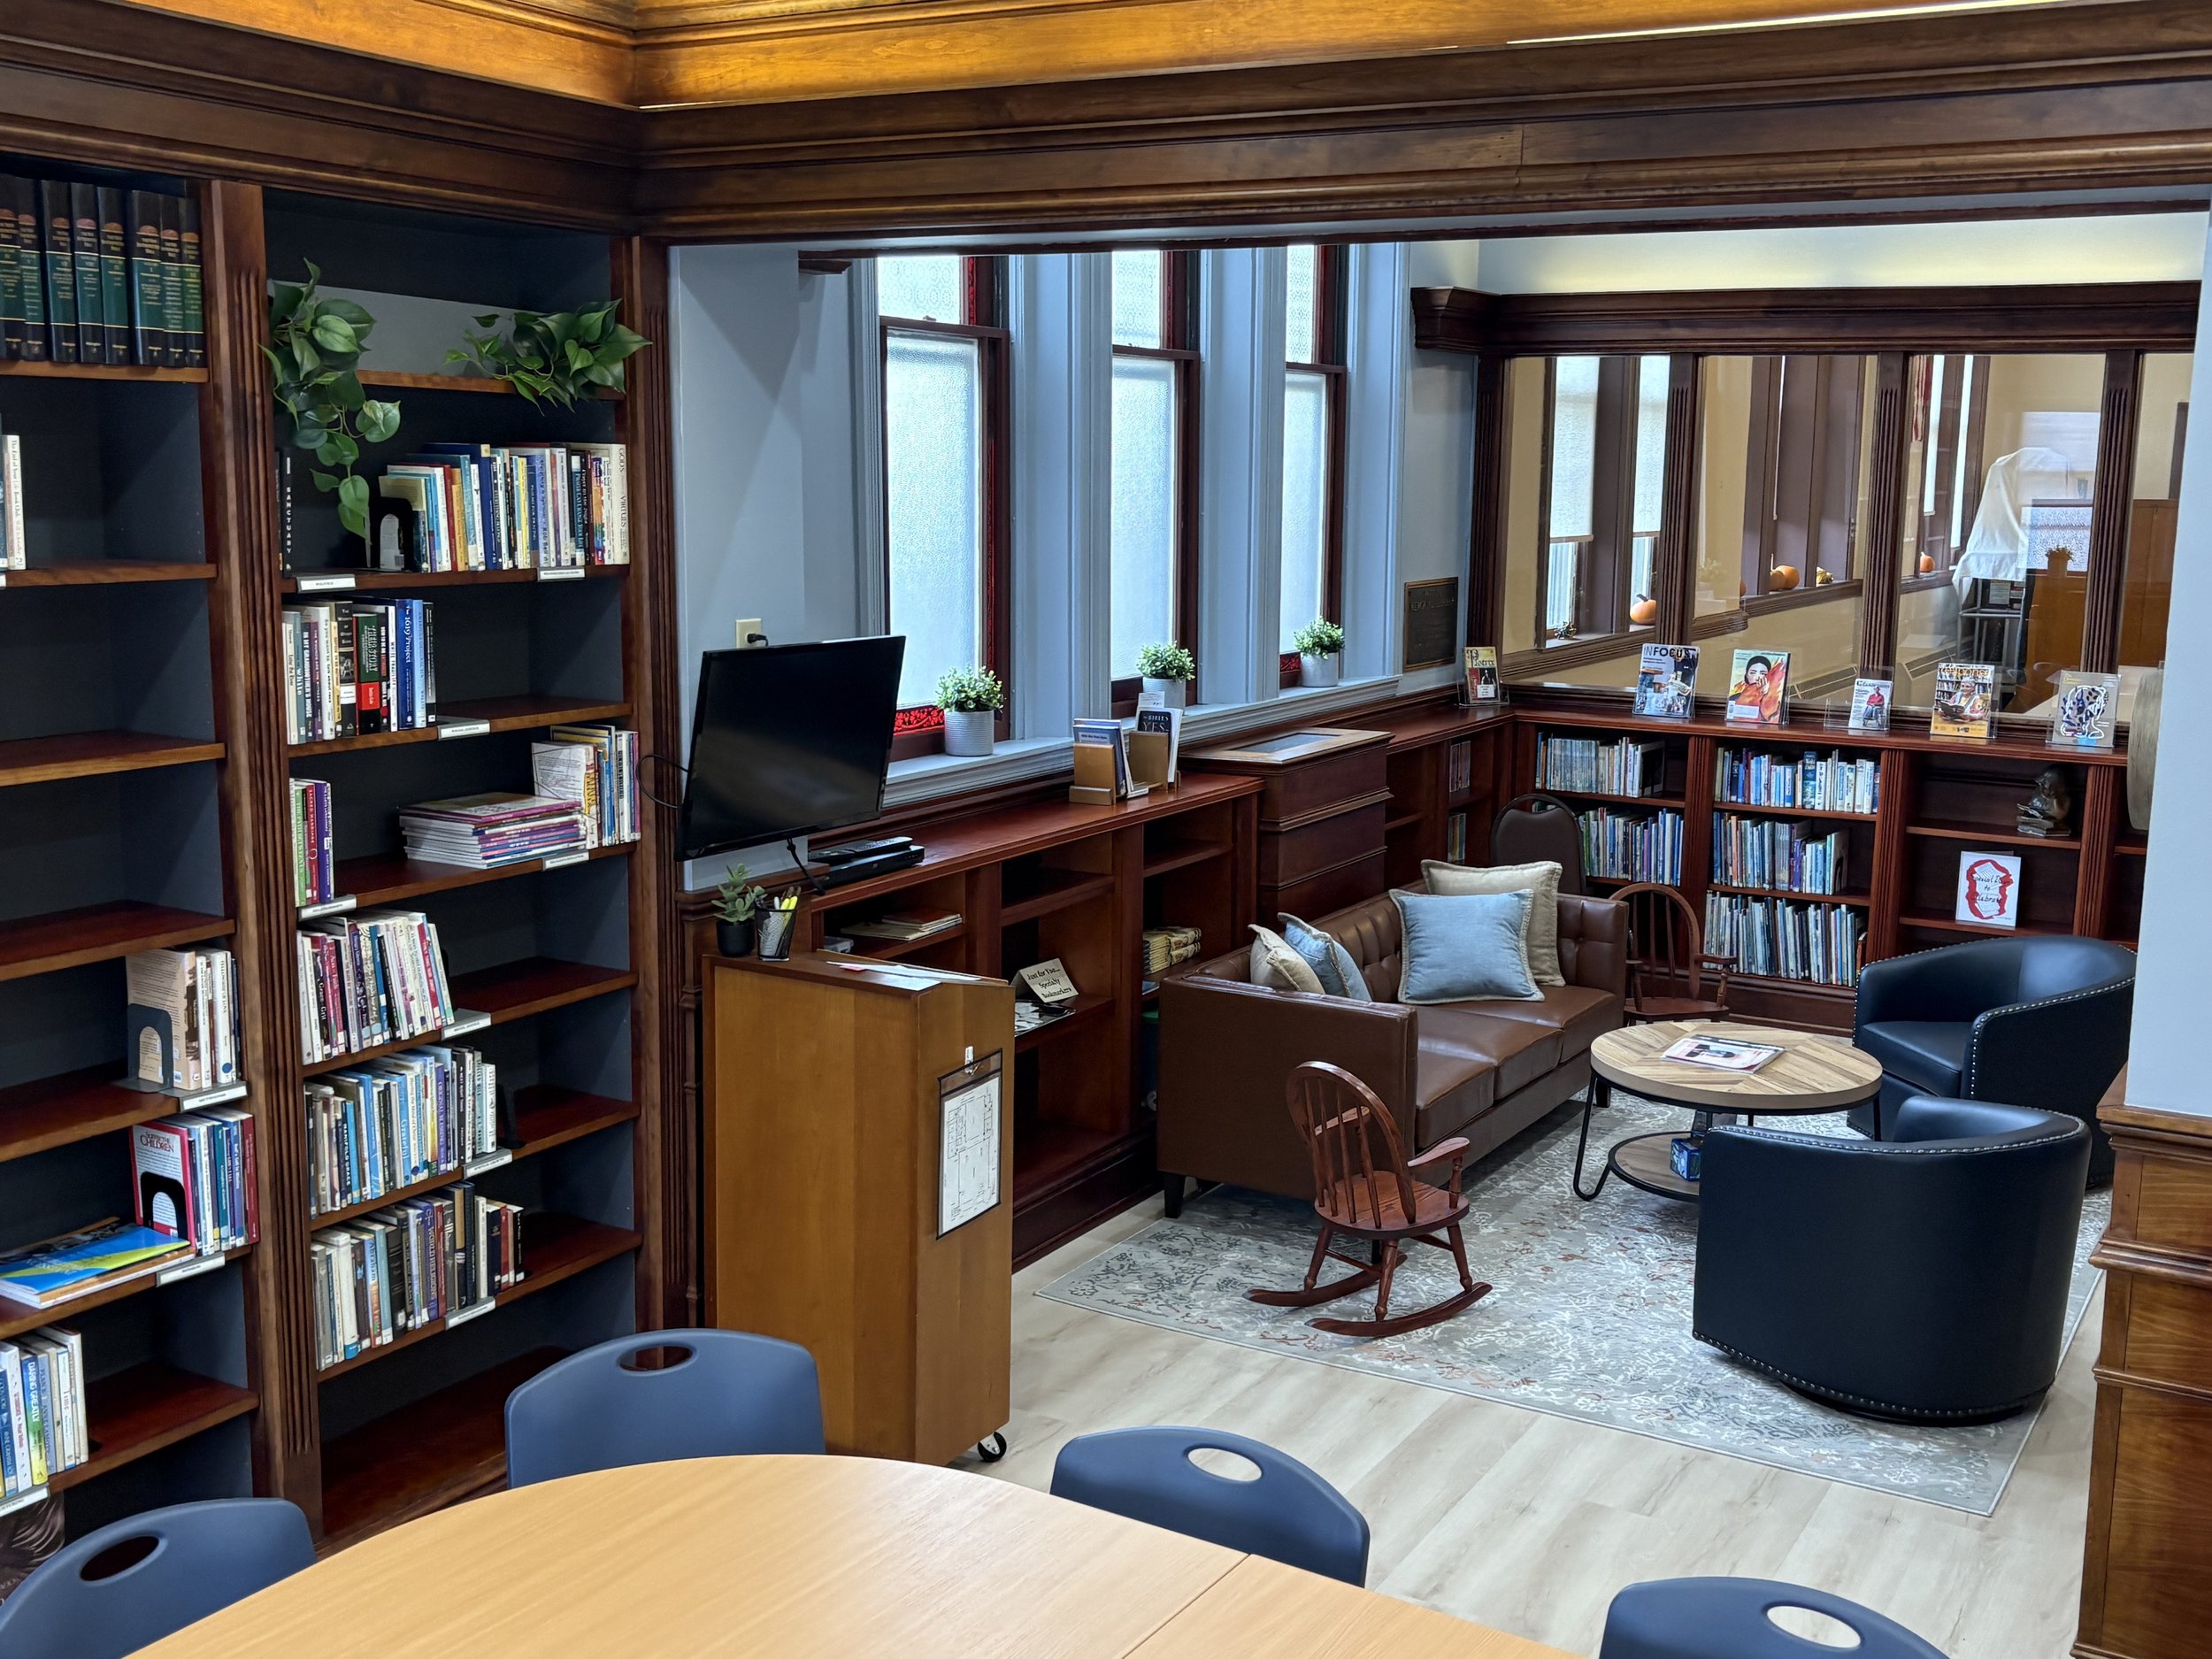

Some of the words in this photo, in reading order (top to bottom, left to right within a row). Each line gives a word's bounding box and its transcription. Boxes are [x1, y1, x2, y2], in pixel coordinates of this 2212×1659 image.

[401, 1119, 410, 1159] Grateful
[27, 1362, 36, 1390] DARING
[29, 1391, 39, 1423] GREATLY
